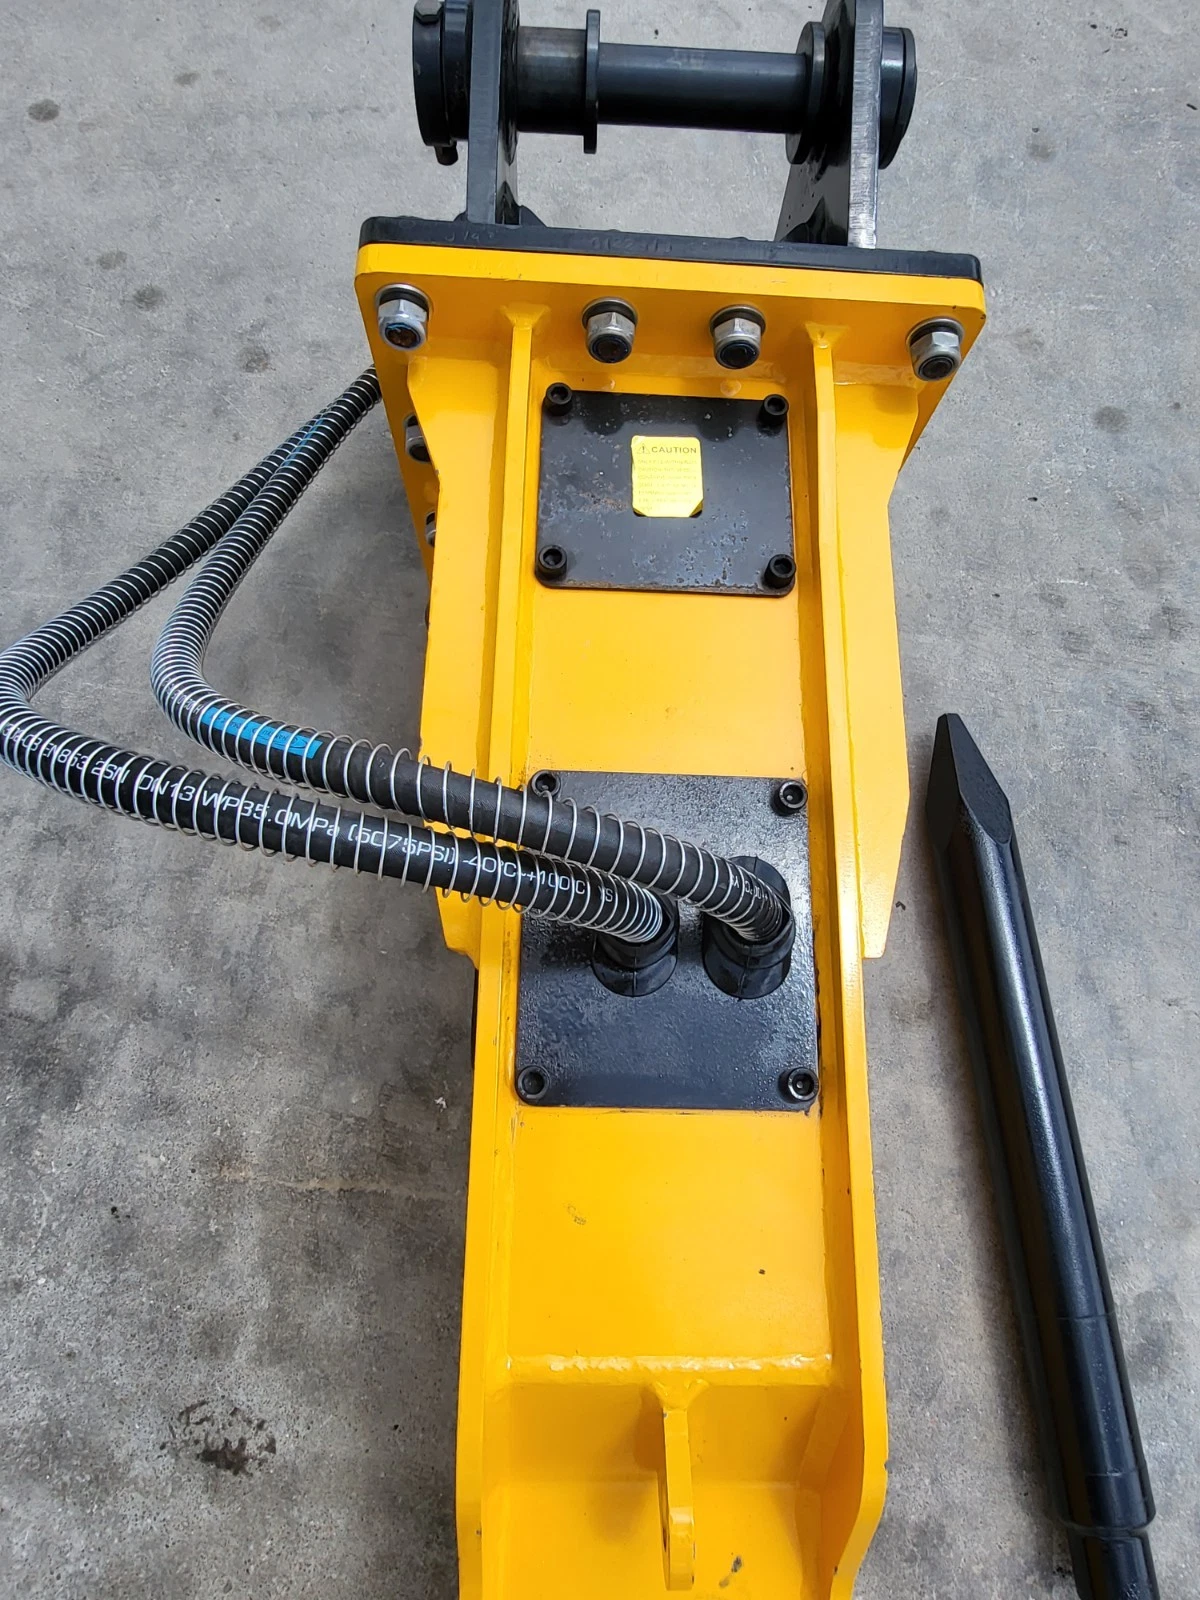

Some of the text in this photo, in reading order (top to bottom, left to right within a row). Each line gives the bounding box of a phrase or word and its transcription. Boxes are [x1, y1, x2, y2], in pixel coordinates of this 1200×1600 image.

[651, 446, 697, 454] CAUTION
[91, 759, 131, 784] 2SN
[138, 774, 196, 801] DN13
